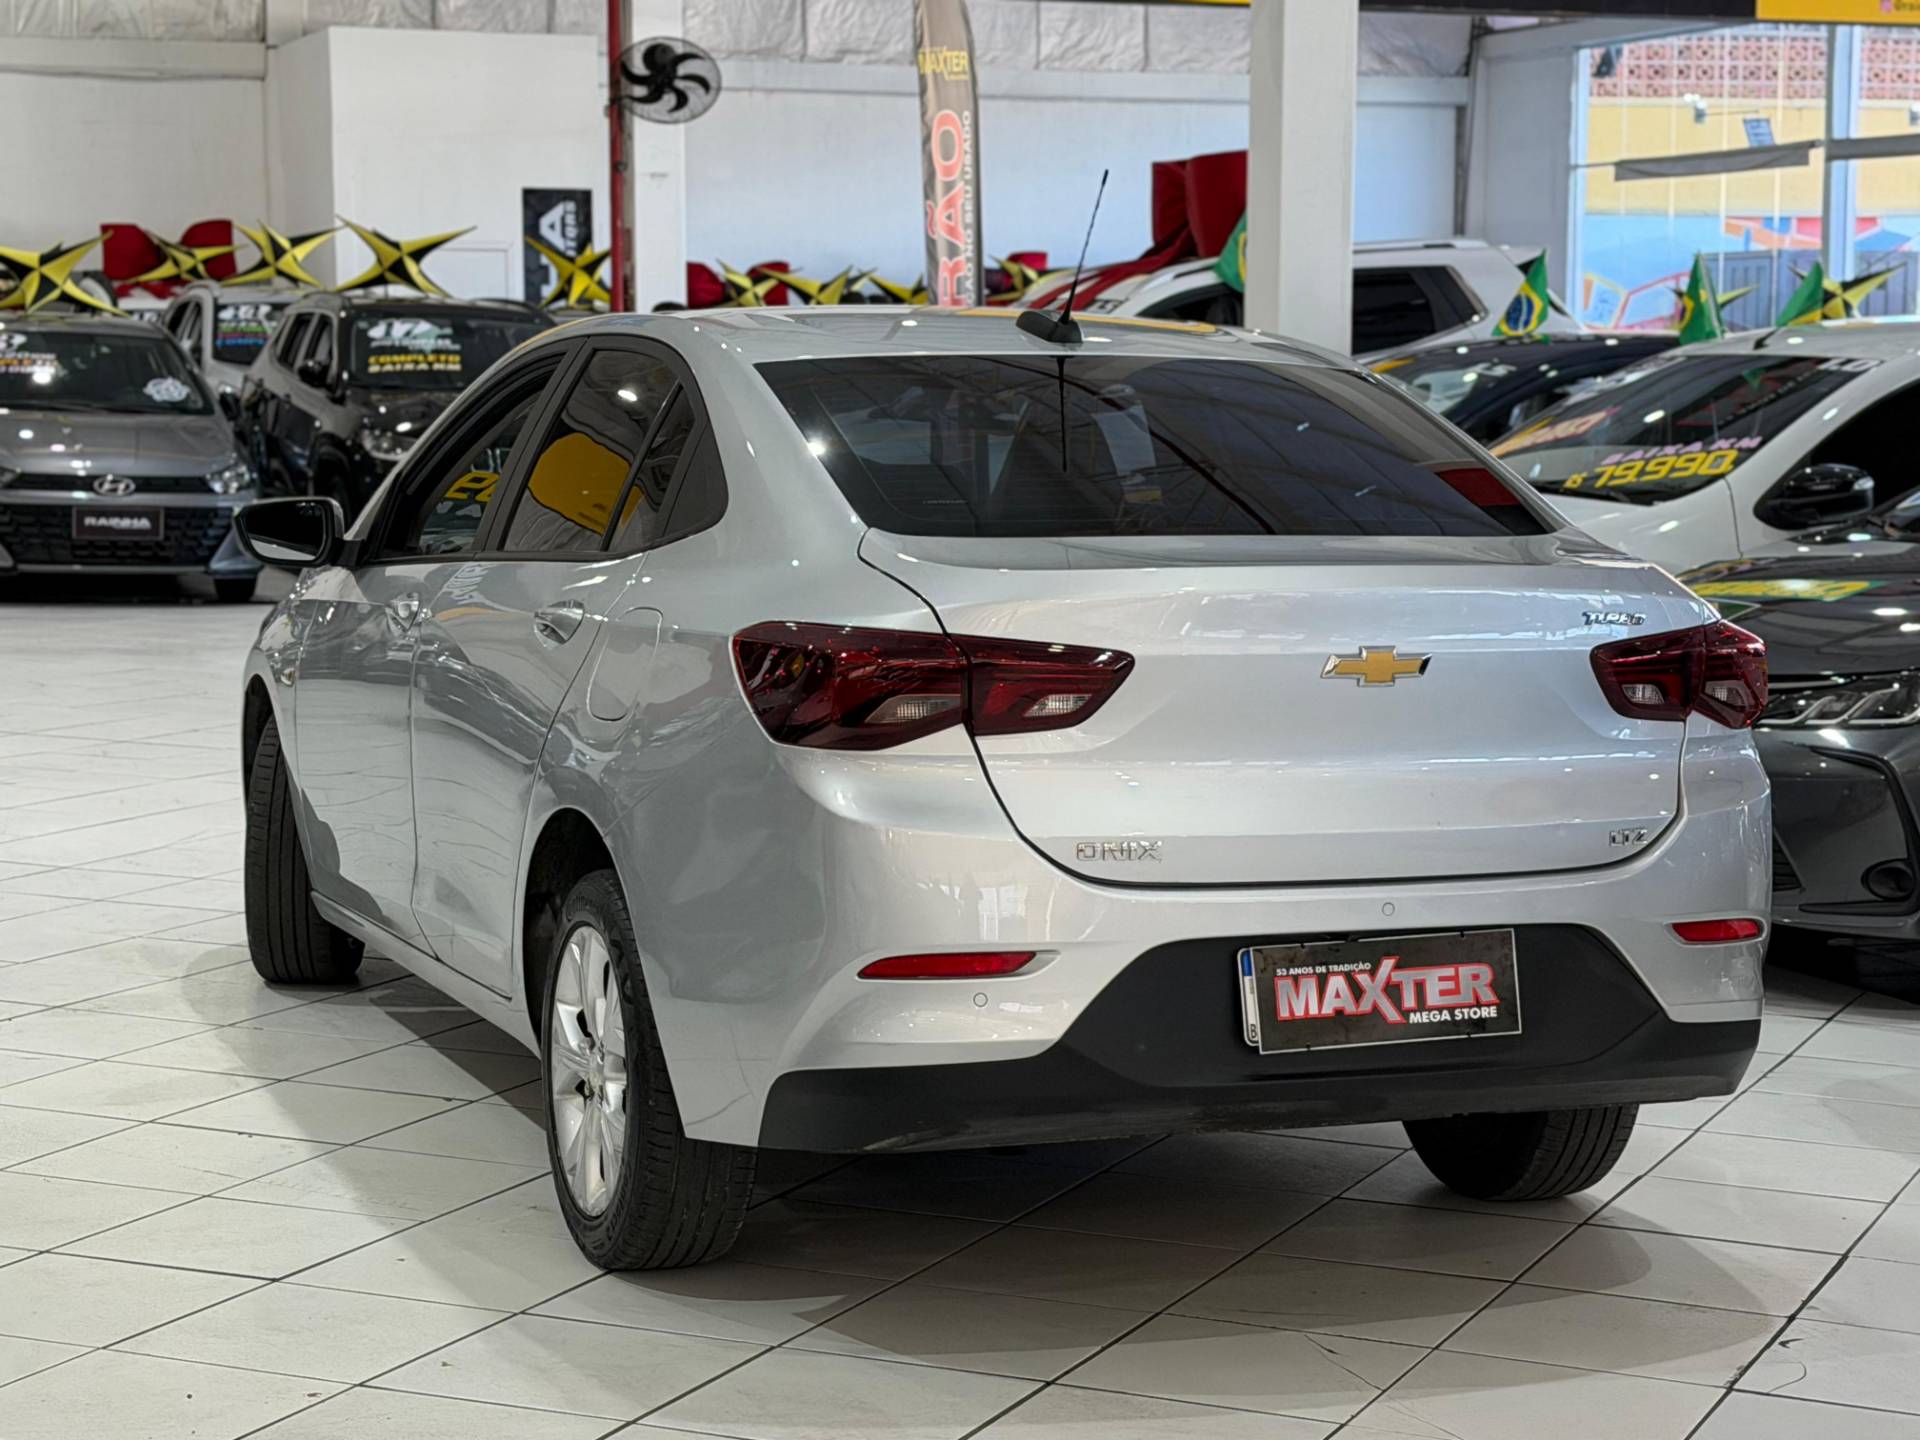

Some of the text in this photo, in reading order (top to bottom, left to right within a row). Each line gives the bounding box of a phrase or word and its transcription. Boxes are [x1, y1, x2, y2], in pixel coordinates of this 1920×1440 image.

[962, 110, 973, 180] USADO
[1076, 841, 1163, 863] ONIX
[1289, 966, 1314, 976] ANOS
[1315, 965, 1327, 974] DE
[1328, 961, 1372, 973] TRADIÇÃO
[1274, 956, 1500, 1024] MAXTER
[1409, 1006, 1498, 1024] MEGA STORE
